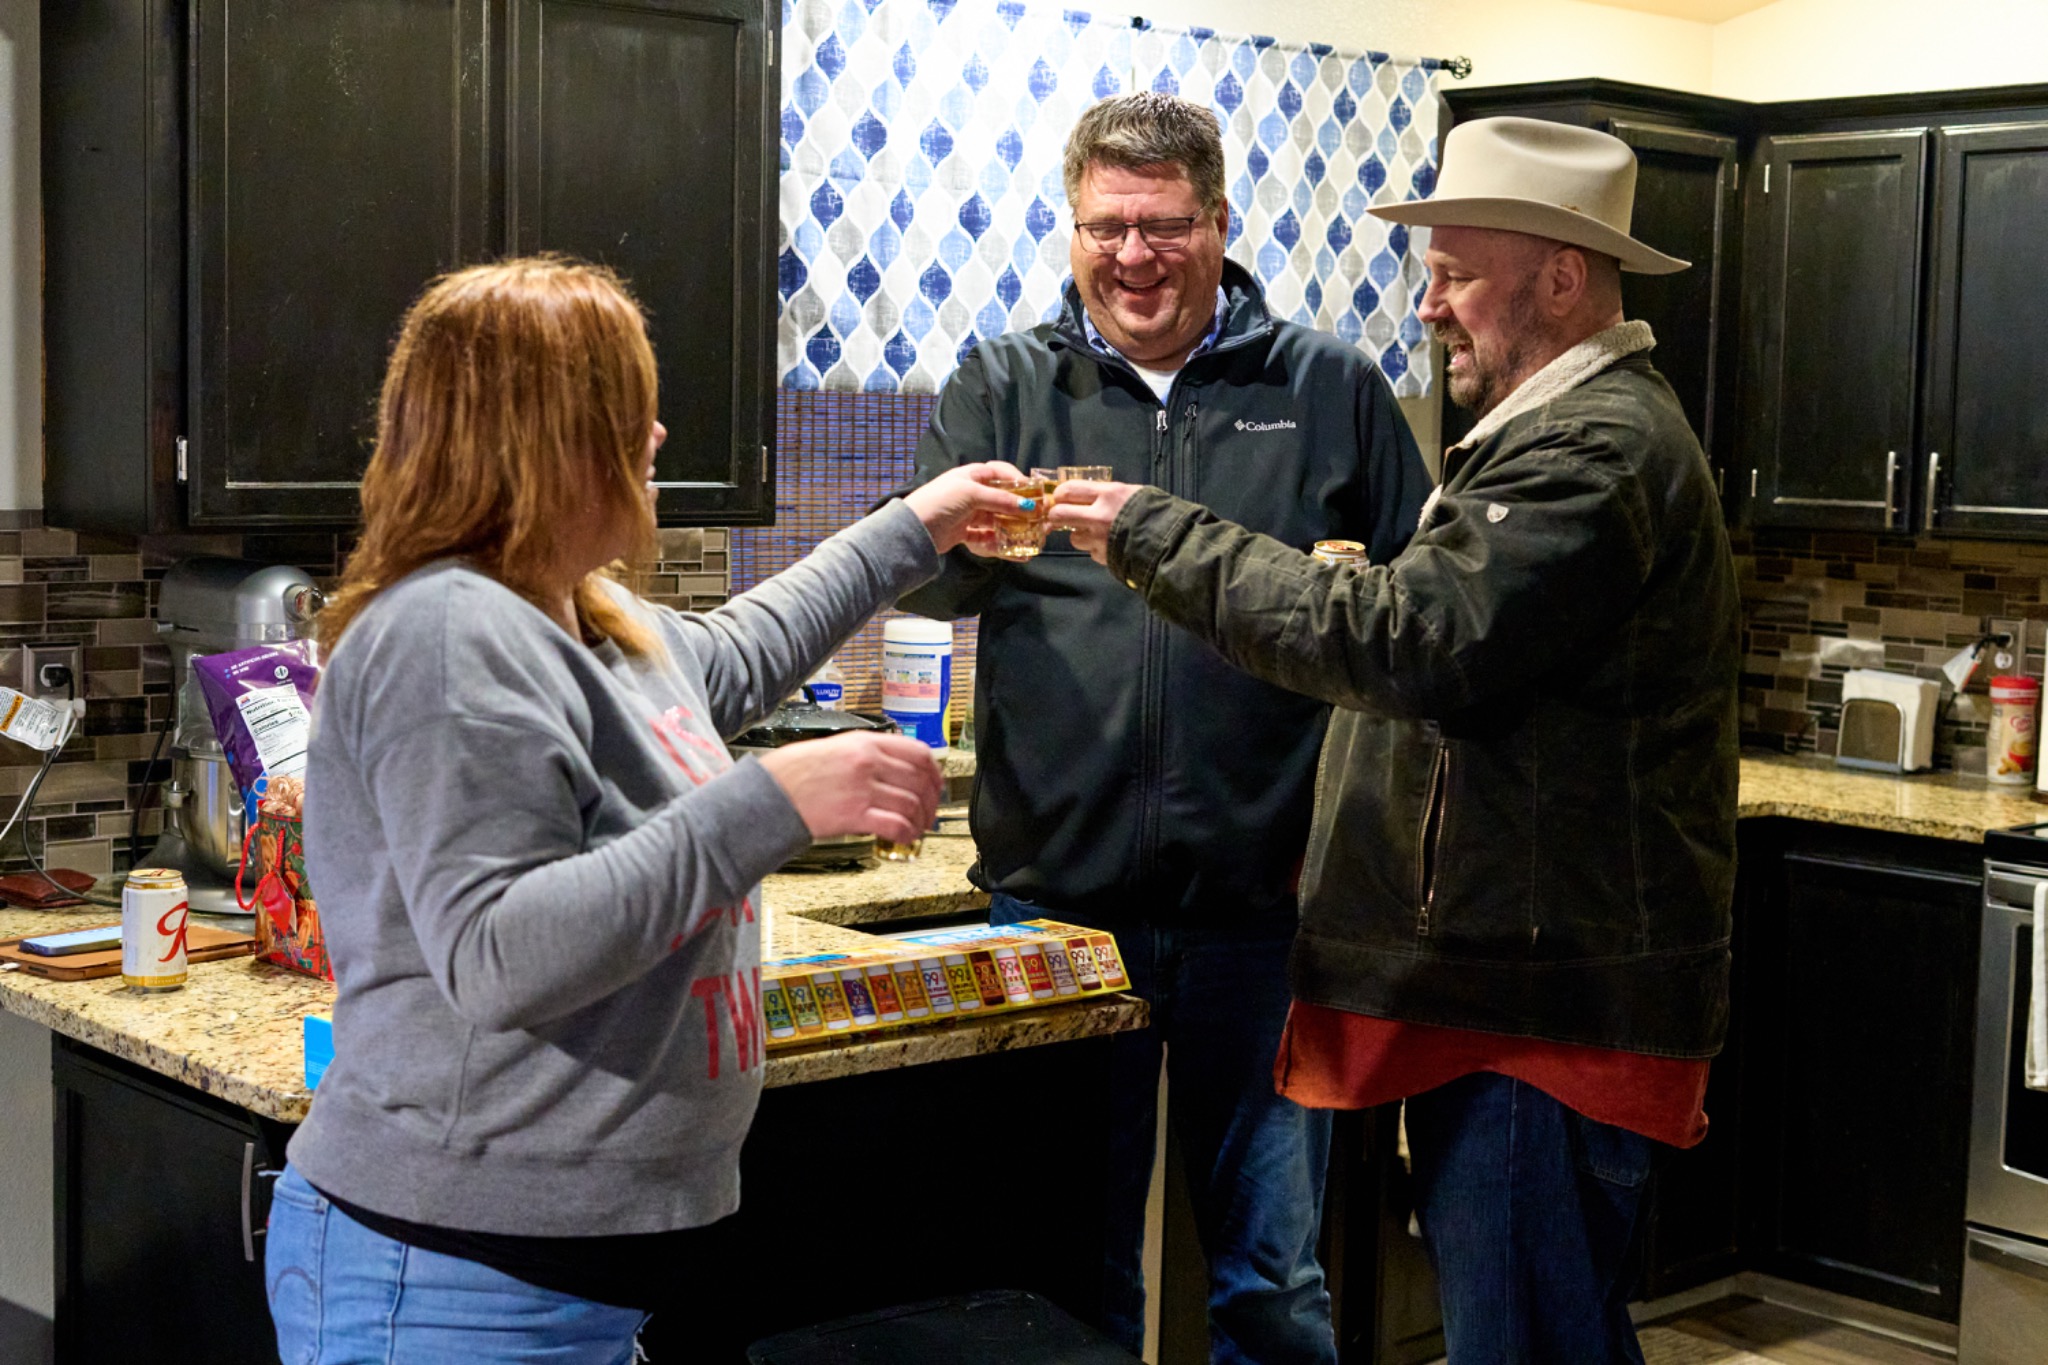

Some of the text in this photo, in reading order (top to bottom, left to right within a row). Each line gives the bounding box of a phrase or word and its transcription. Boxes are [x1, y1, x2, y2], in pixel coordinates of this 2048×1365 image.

[1245, 420, 1297, 431] Columbia
[1071, 950, 1085, 963] 99
[924, 971, 939, 987] 99
